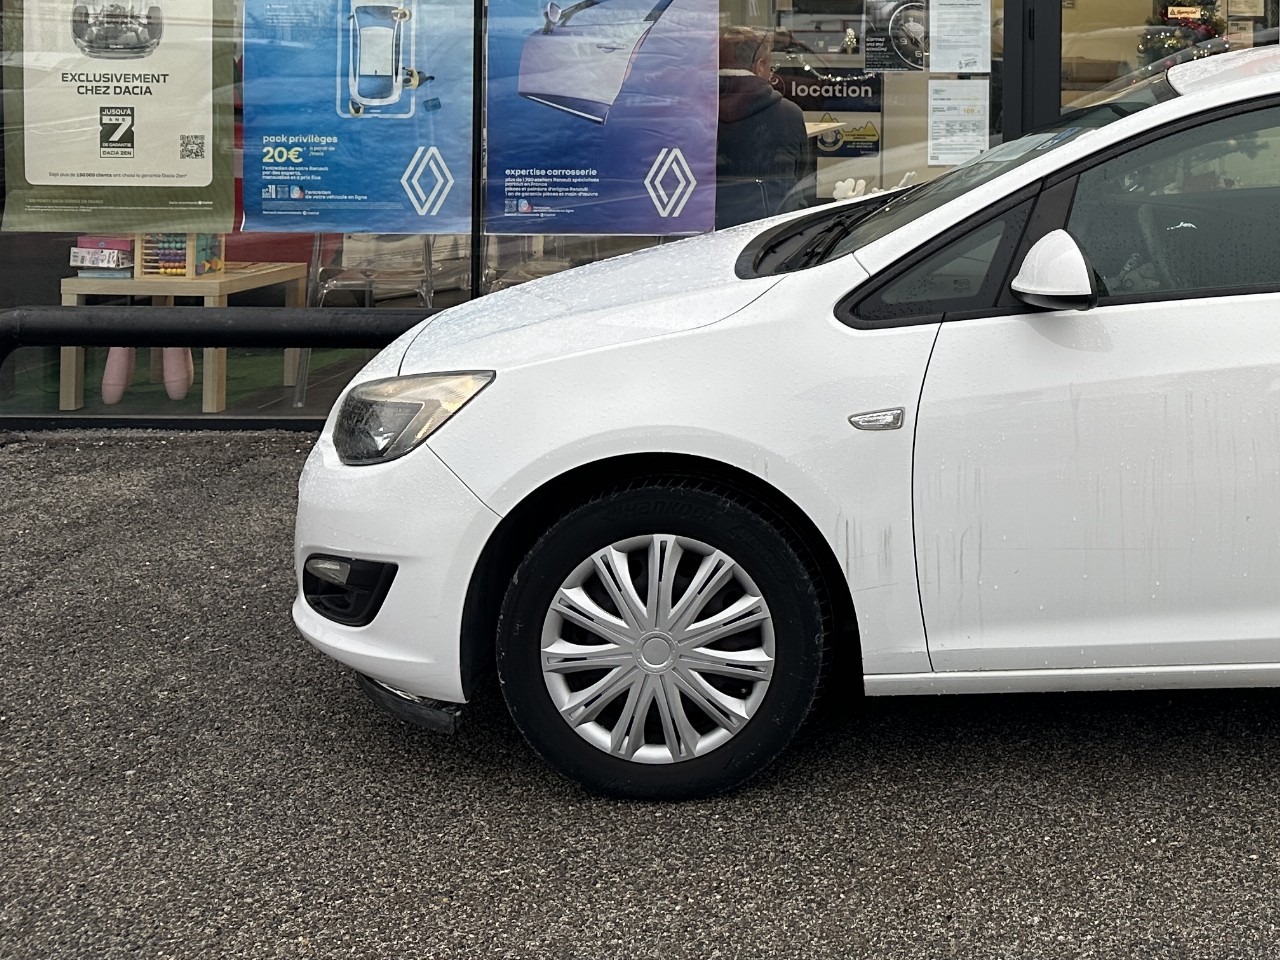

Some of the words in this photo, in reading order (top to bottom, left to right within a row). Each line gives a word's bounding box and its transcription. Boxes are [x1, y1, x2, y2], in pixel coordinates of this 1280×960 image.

[61, 72, 169, 83] EXCLUSIVEMENT
[77, 85, 111, 95] CHEZ
[113, 86, 153, 95] DACIA
[791, 81, 872, 98] location
[102, 107, 132, 115] JUSQU'À
[101, 116, 132, 142] 7
[262, 134, 288, 144] pack
[288, 134, 338, 145] privilèges
[505, 168, 546, 177] expertise
[546, 168, 597, 176] carrosserie
